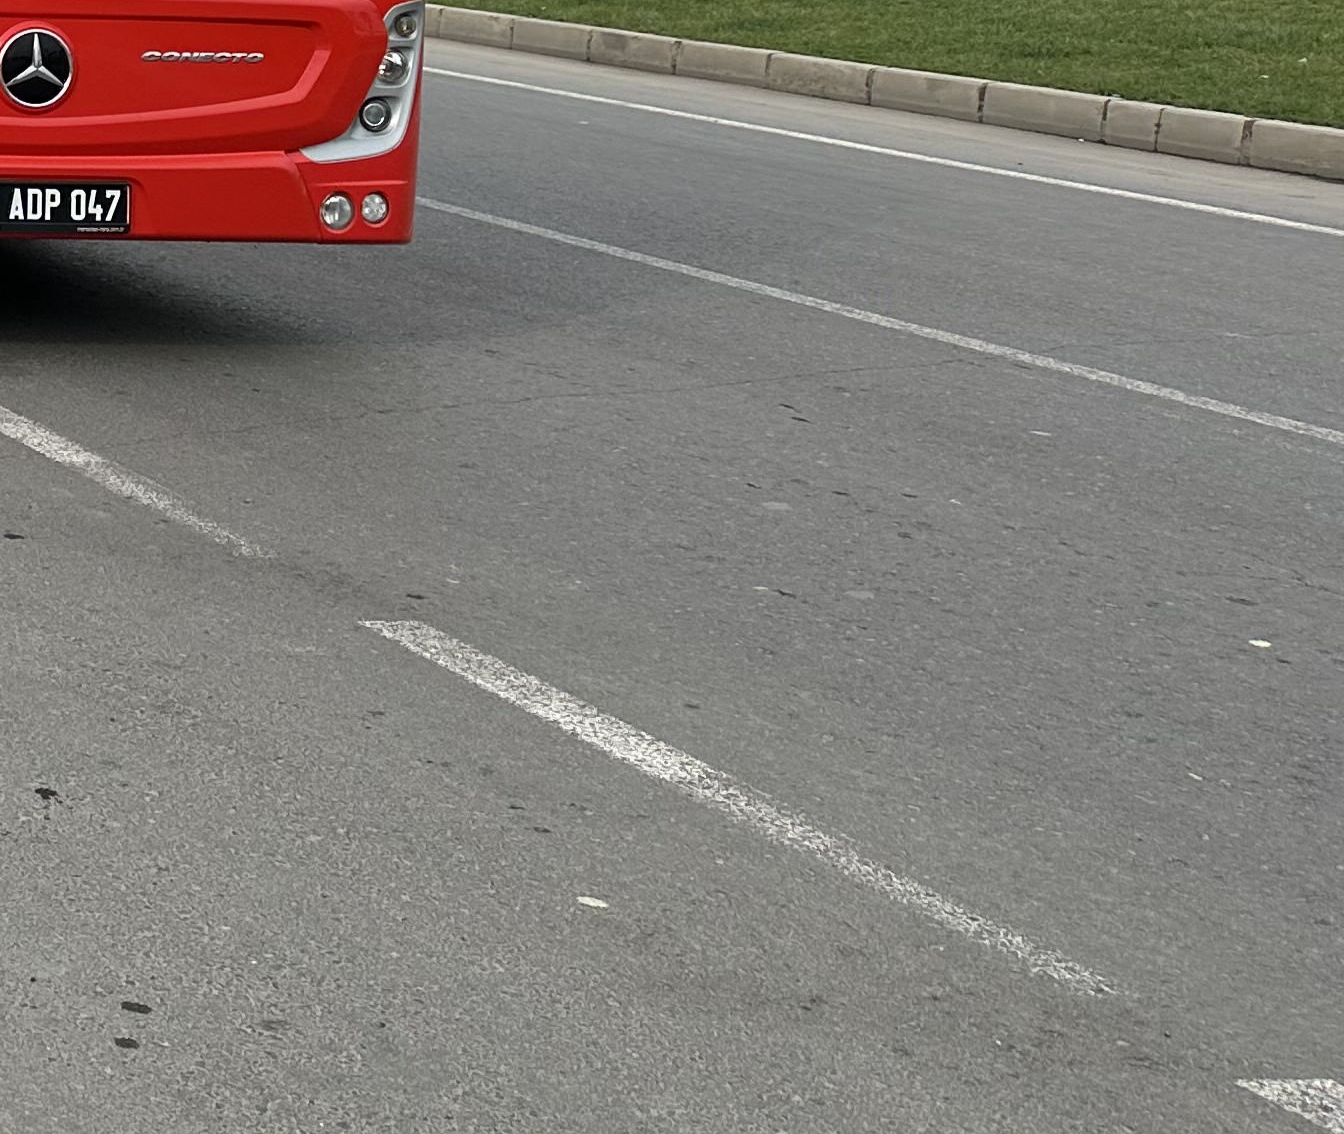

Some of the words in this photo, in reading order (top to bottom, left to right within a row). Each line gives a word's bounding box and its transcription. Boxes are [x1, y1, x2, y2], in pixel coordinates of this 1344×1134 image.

[140, 51, 265, 63] CONECTO
[9, 187, 61, 221] ADP
[70, 189, 122, 222] 047
